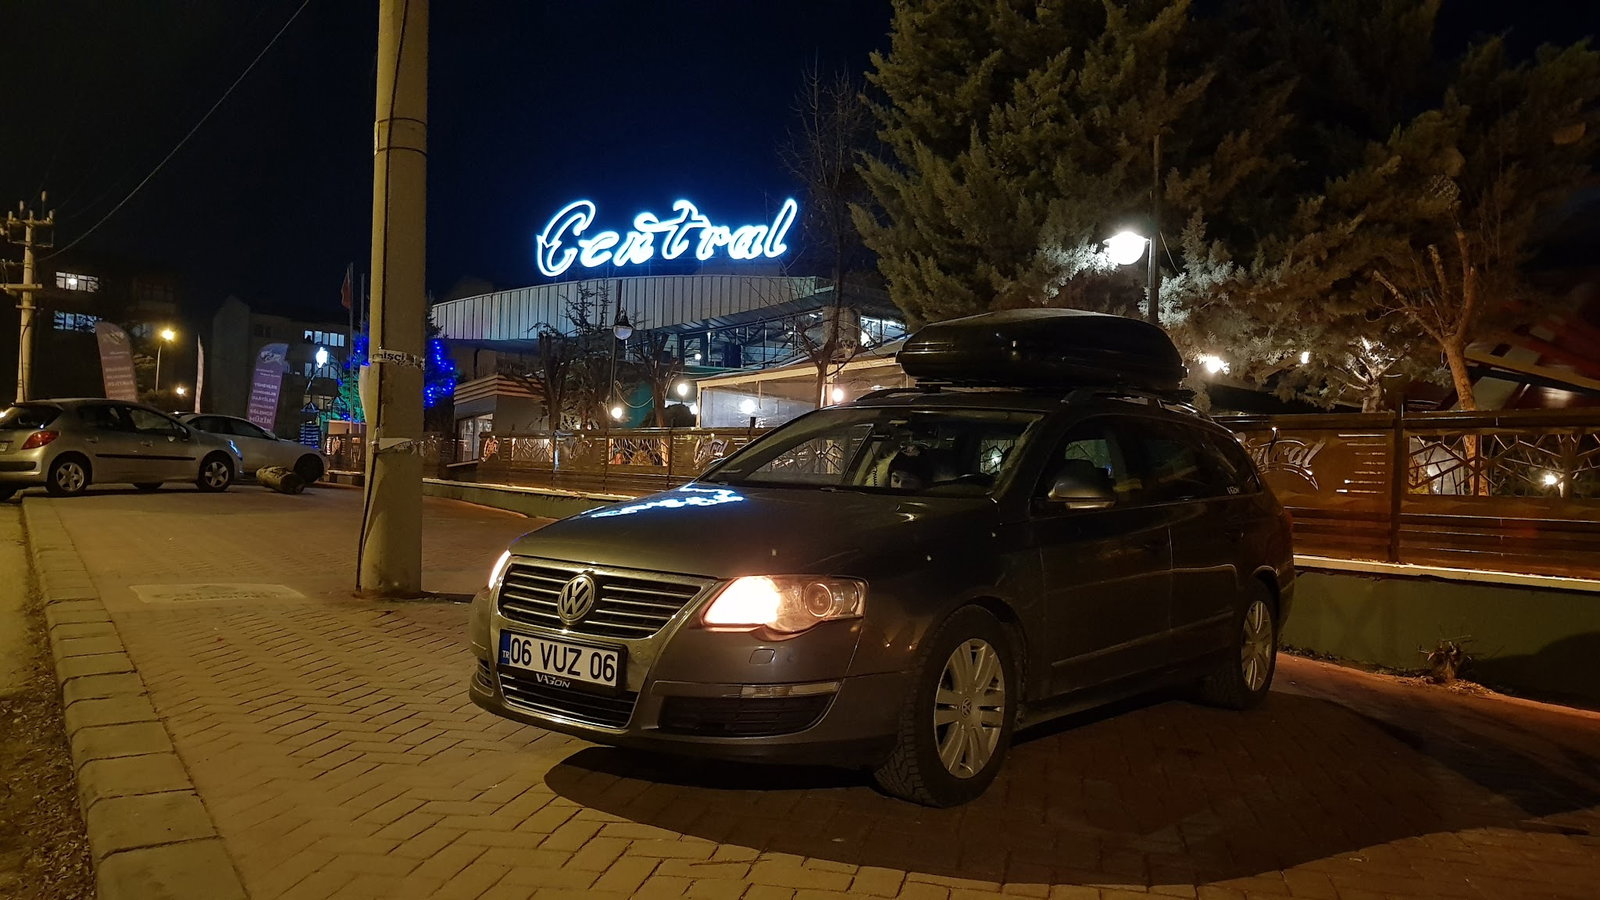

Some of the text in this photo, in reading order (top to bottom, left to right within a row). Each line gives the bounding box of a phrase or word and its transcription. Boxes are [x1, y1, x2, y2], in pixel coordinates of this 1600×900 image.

[536, 198, 797, 276] Central
[502, 650, 510, 659] TR
[510, 637, 617, 682] 06 VUZ 06
